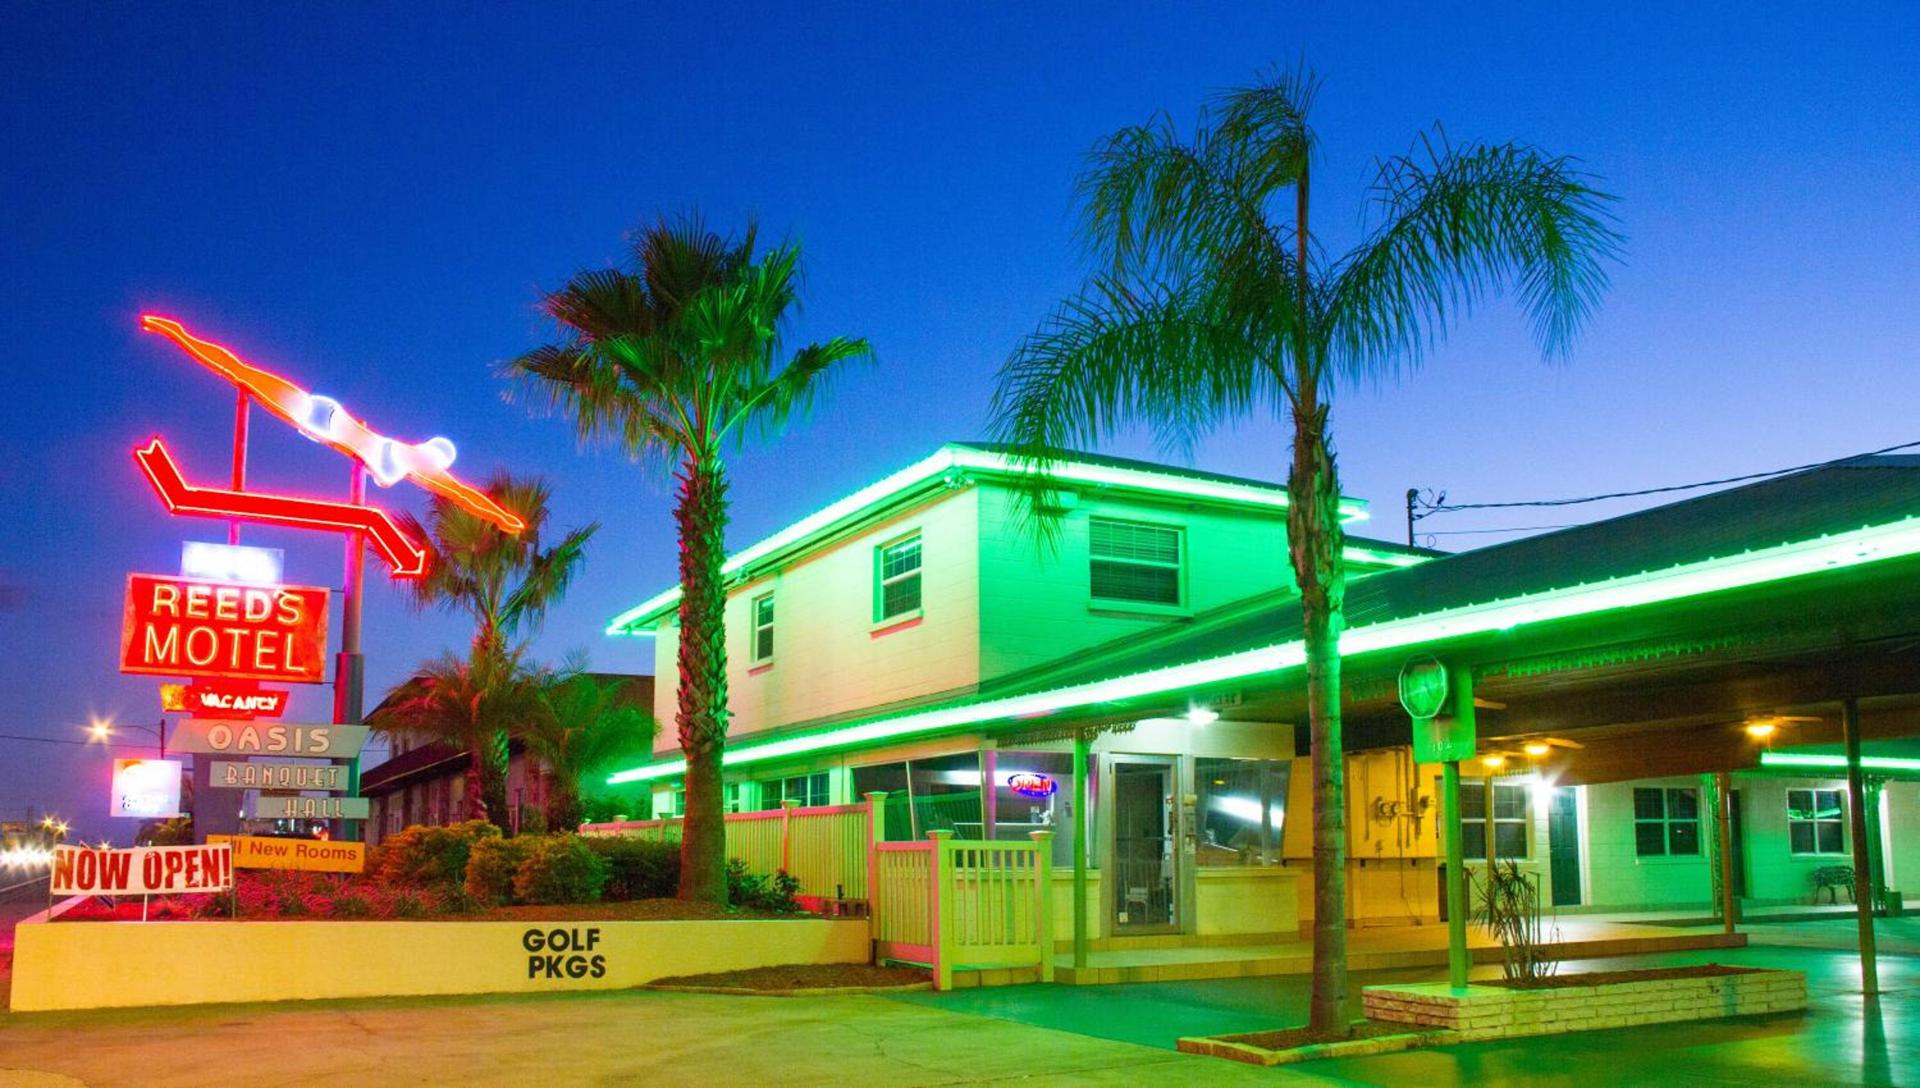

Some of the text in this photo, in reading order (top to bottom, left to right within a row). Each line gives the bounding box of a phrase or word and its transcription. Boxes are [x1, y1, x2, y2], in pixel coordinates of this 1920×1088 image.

[152, 583, 304, 624] REED'S
[144, 624, 306, 671] MOTEL
[200, 692, 279, 710] VACANCY
[208, 724, 330, 753] OASIS
[224, 764, 338, 788] BANQUET
[283, 798, 344, 818] HALL
[251, 842, 288, 856] New
[296, 844, 357, 860] Rooms
[53, 848, 231, 890] NOW OPEN!
[522, 928, 601, 952] GOLF
[528, 954, 606, 979] PKGS
